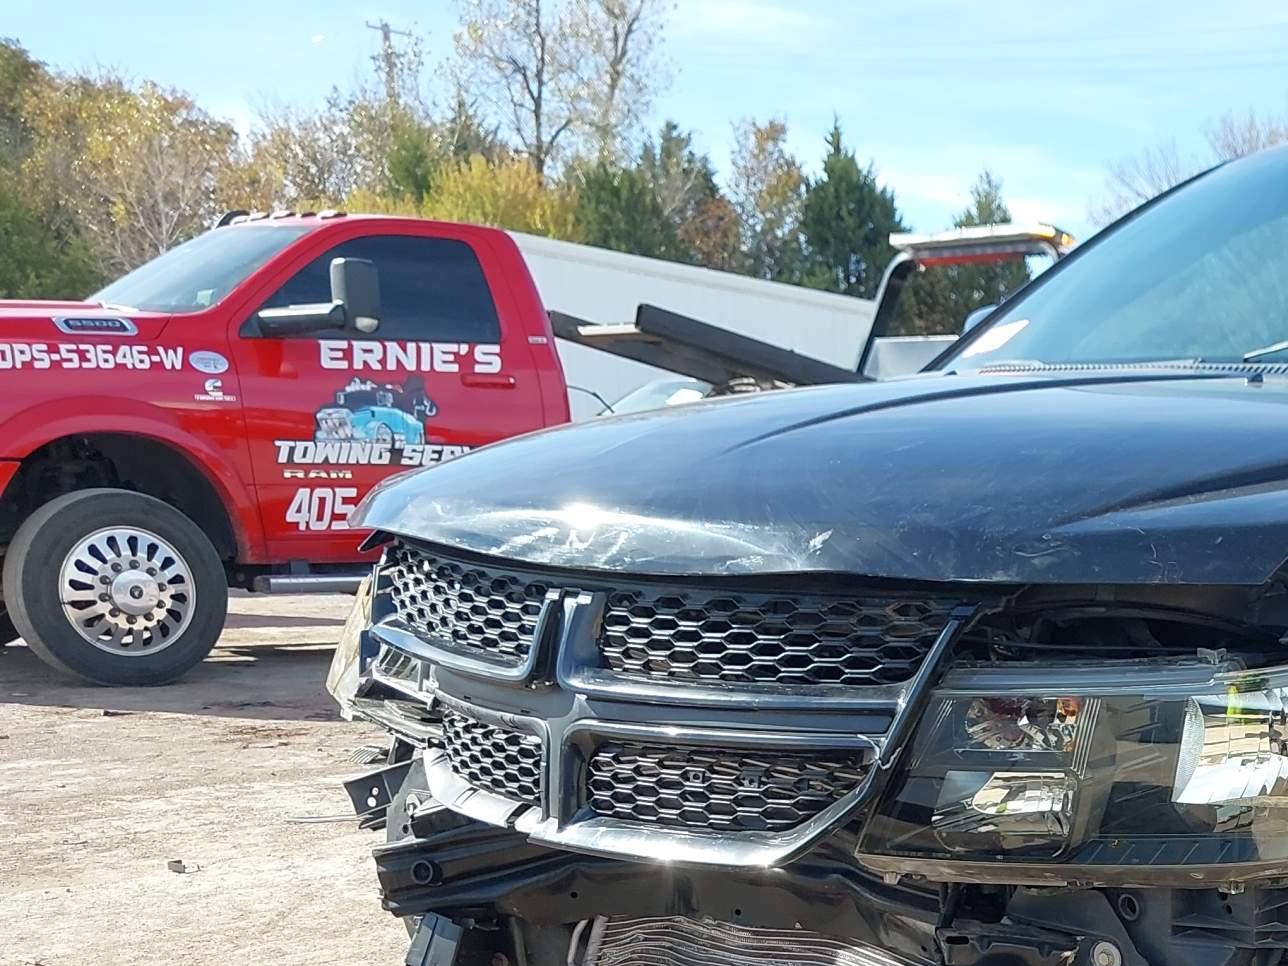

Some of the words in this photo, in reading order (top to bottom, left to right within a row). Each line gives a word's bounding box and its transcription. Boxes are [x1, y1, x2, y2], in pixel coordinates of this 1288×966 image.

[318, 339, 501, 374] ERNIE'S
[274, 440, 391, 465] TOWING
[283, 469, 353, 479] RAM
[285, 487, 358, 531] 405
